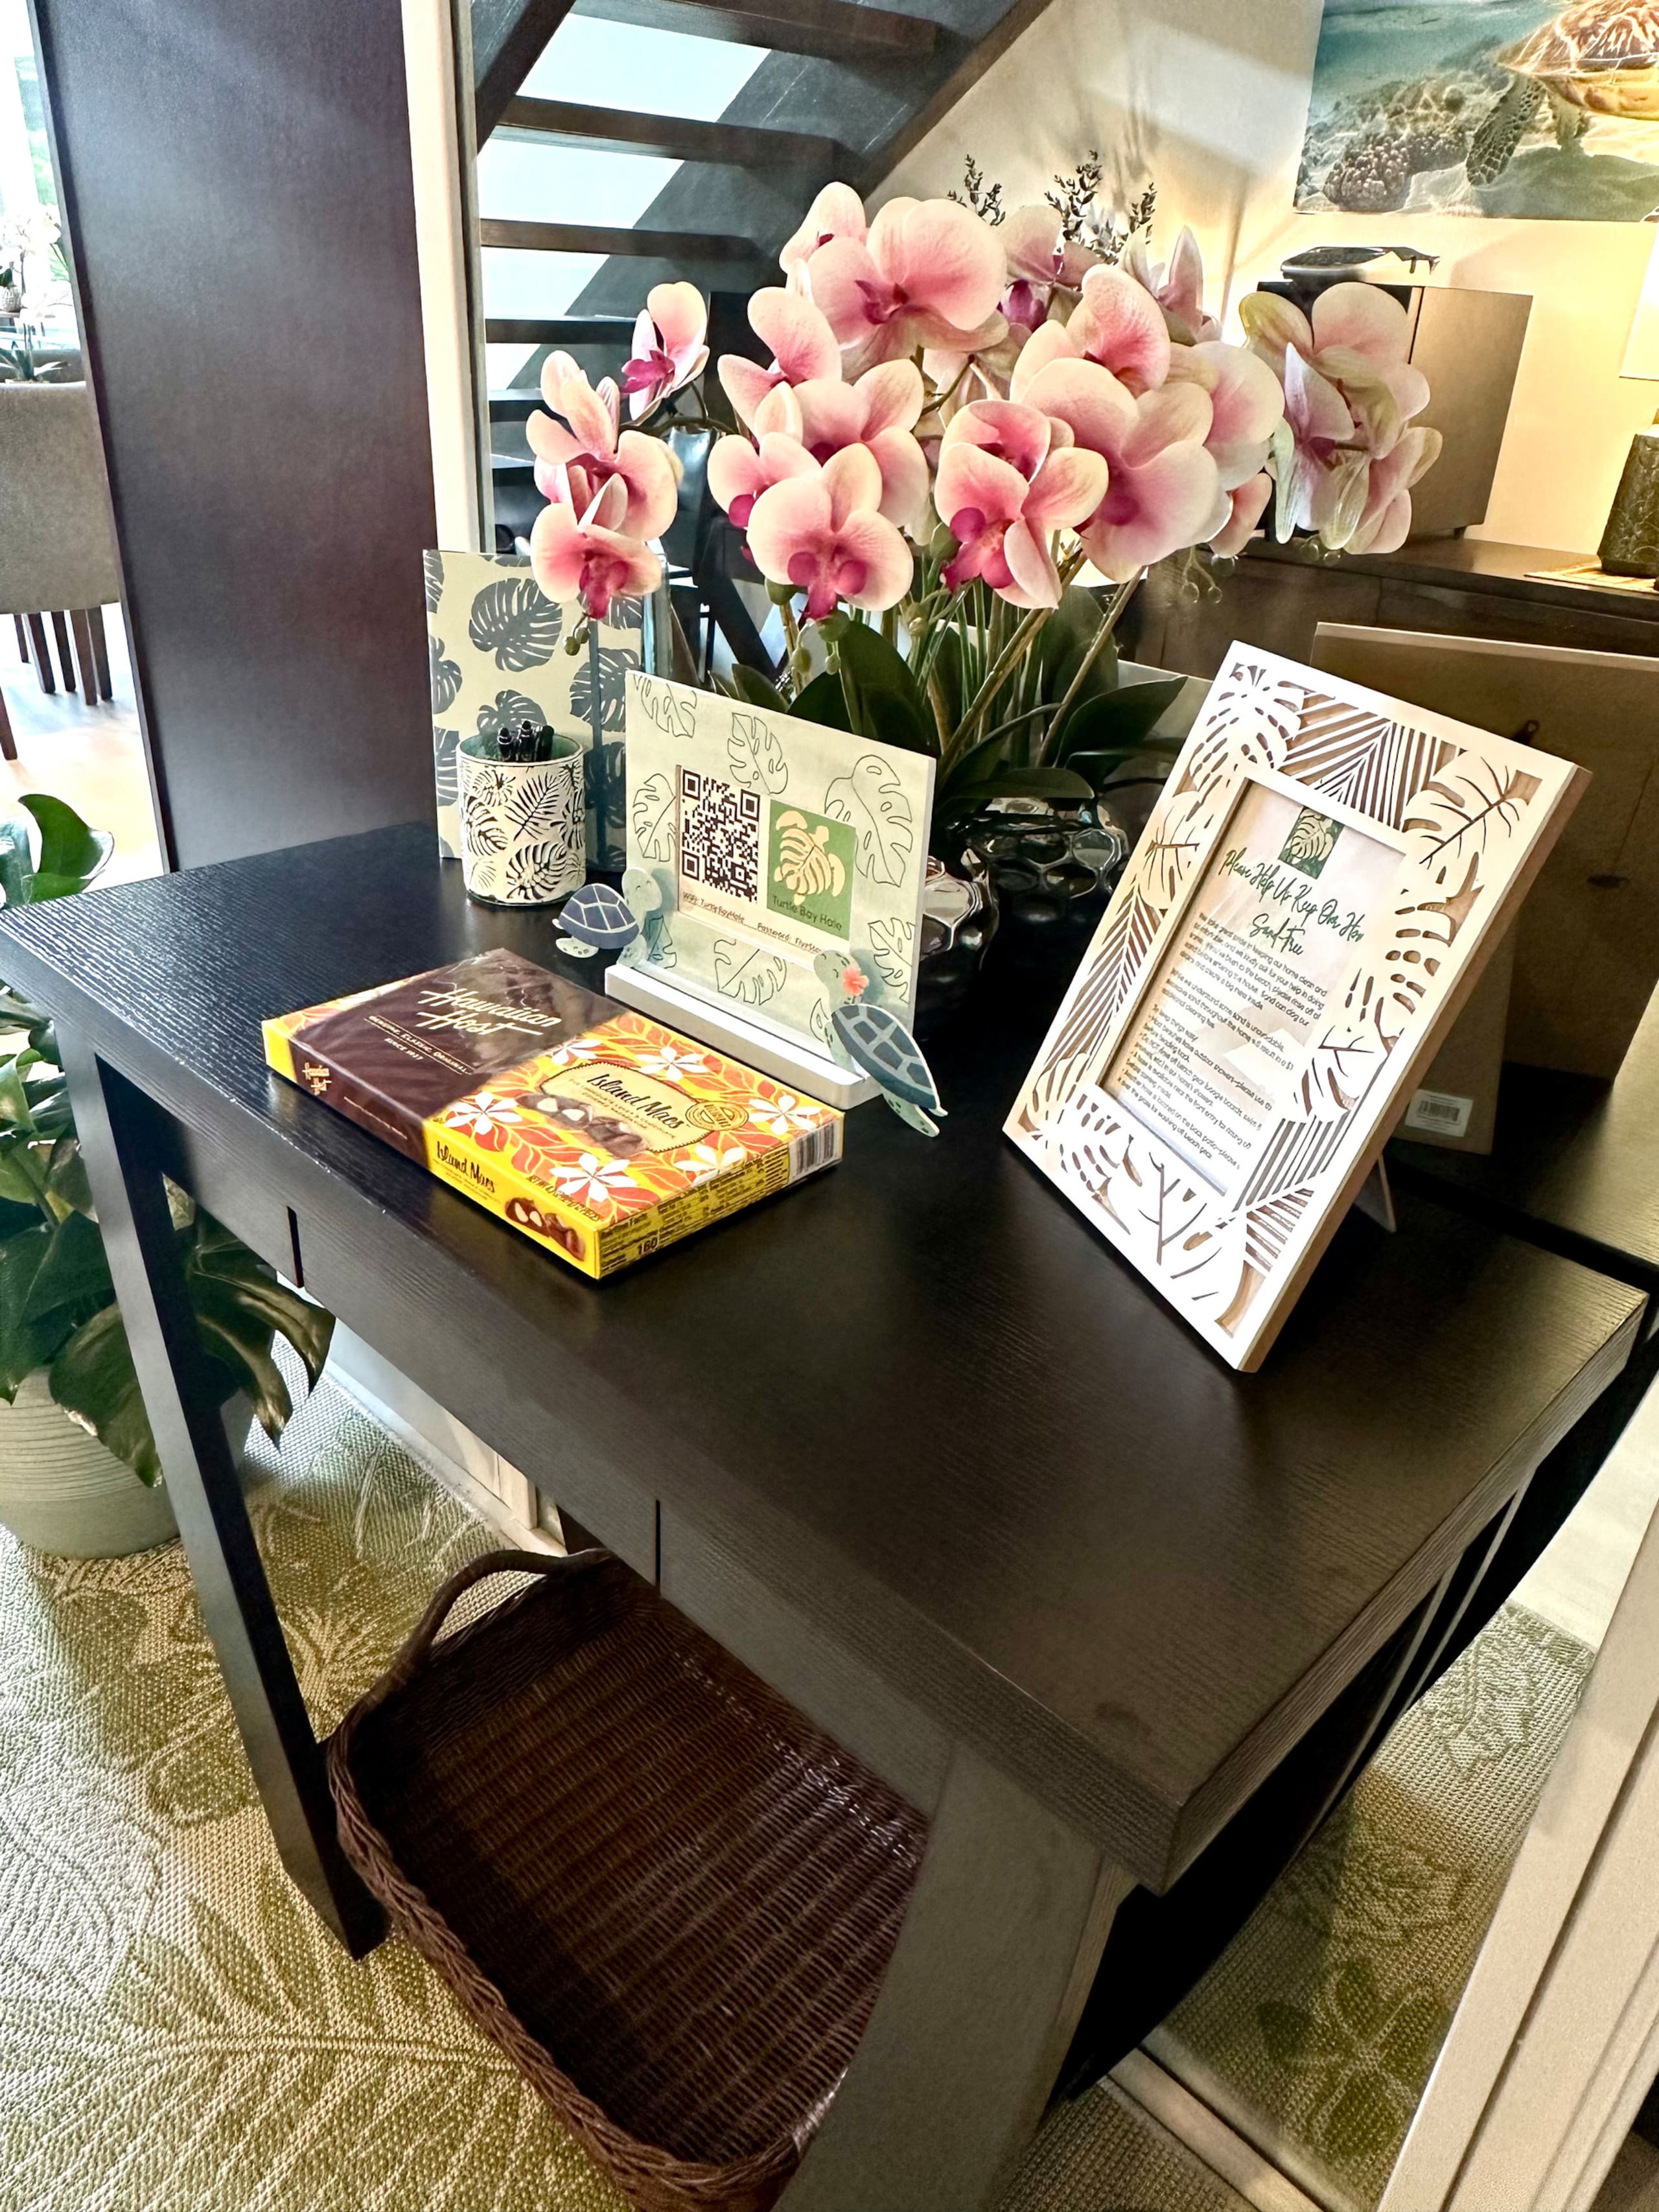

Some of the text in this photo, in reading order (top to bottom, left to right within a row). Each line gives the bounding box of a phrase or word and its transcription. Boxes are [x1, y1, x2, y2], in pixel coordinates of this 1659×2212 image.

[772, 896, 843, 931] Turtle Bay Hale
[1218, 846, 1365, 942] Please Help Us Keep Our Hom
[415, 1010, 543, 1036] Host
[417, 988, 562, 1027] Hawaiian
[586, 1074, 650, 1106] Island
[636, 1101, 684, 1129] Macs
[437, 1141, 469, 1177] Island
[470, 1161, 495, 1193] Macs
[638, 1237, 658, 1256] 160
